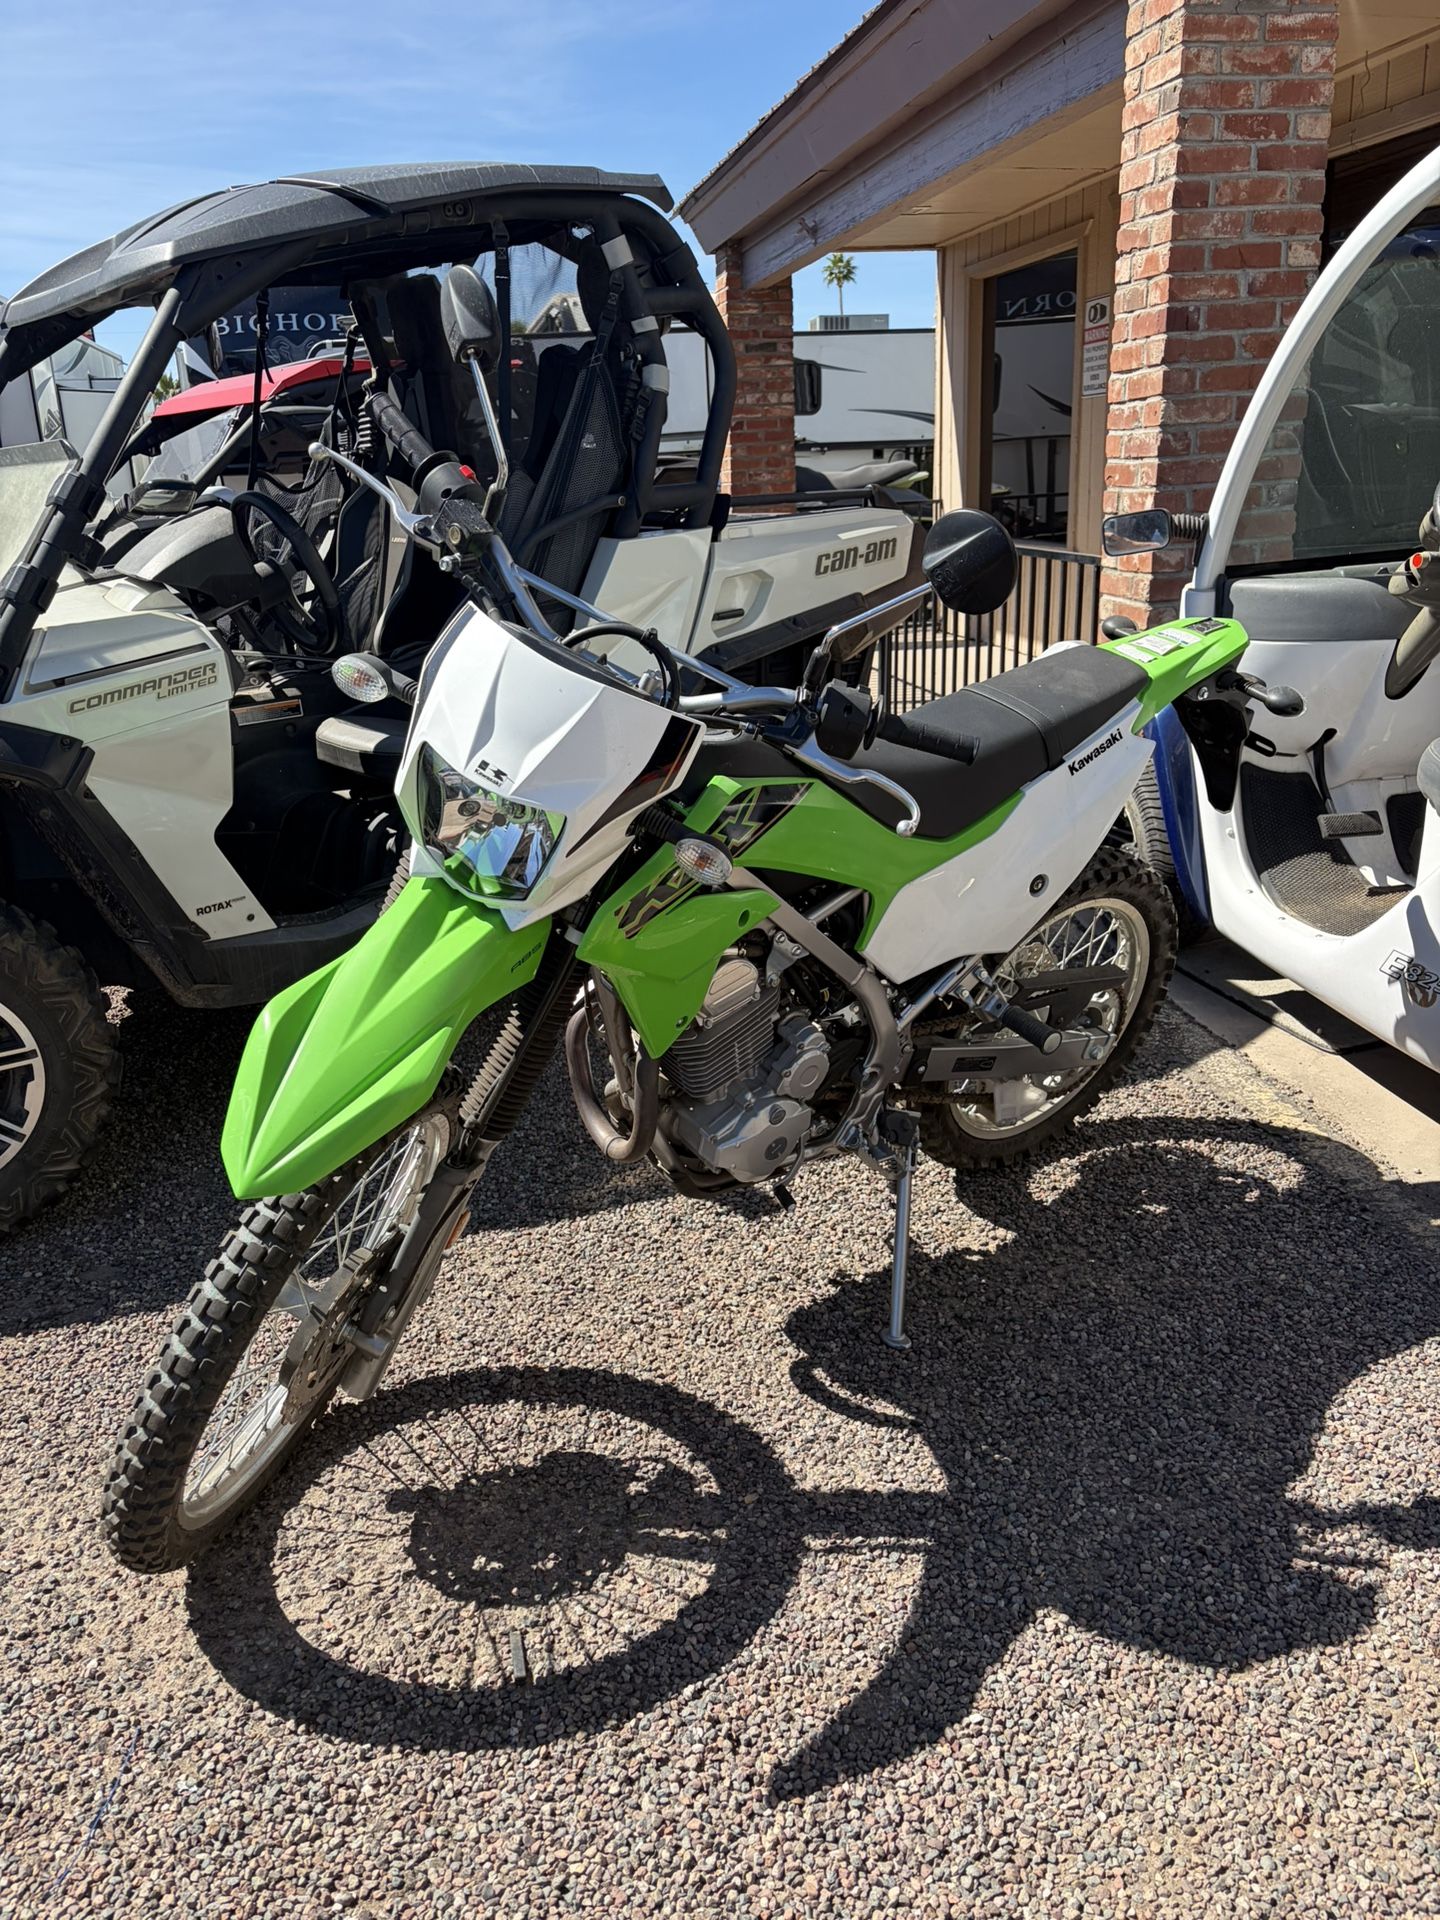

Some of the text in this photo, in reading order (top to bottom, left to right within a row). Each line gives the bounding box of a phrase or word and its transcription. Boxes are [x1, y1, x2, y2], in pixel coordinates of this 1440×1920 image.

[814, 537, 897, 576] can-am
[69, 662, 217, 714] COMMANDER
[157, 675, 217, 700] LIMITED
[1067, 728, 1123, 776] Kawasaki
[196, 899, 232, 916] ROTAX
